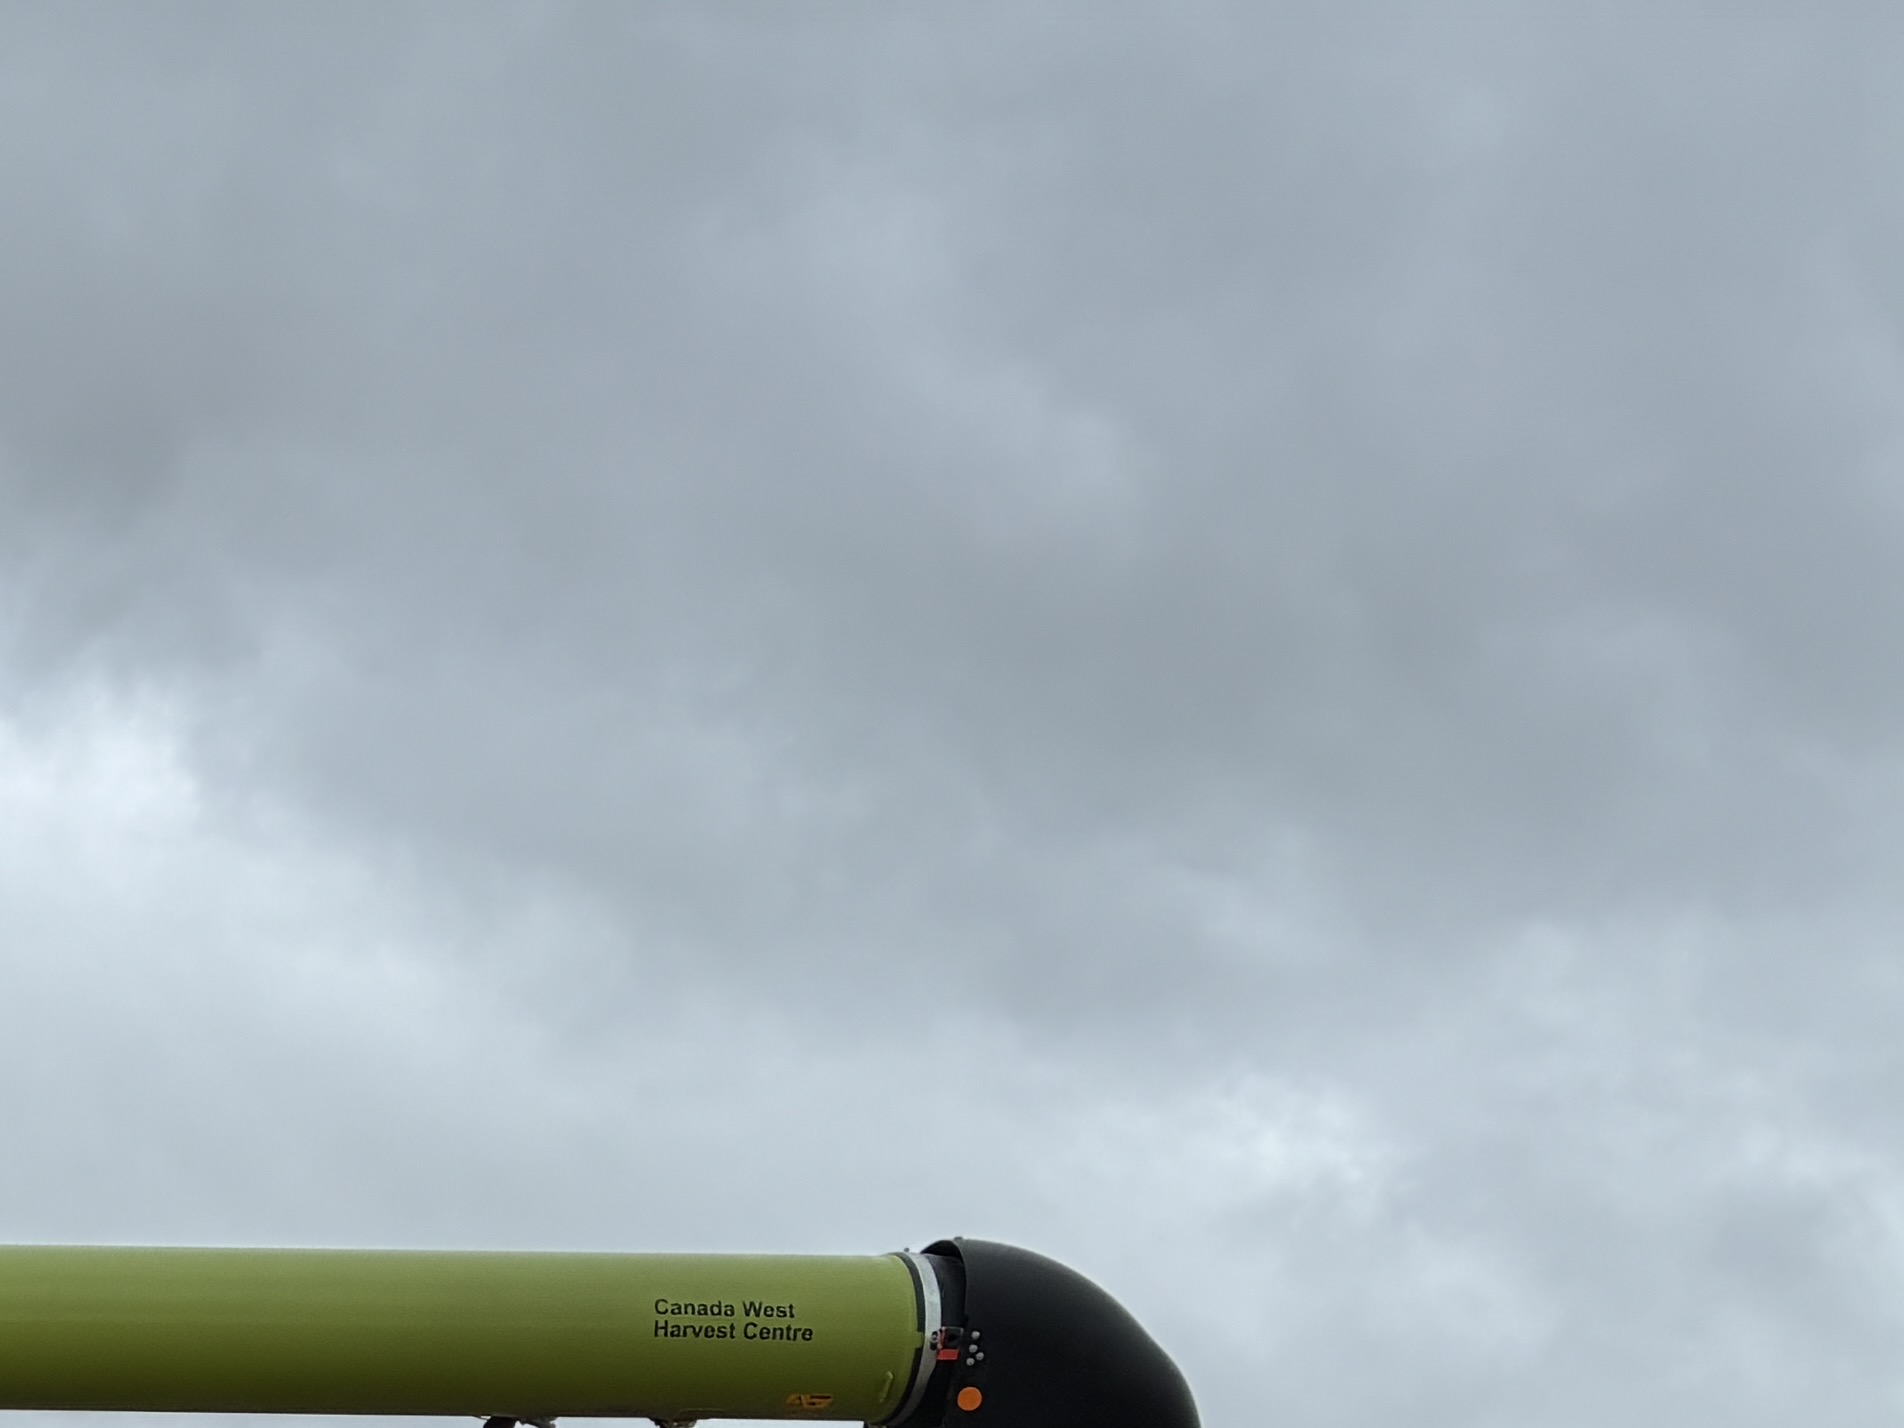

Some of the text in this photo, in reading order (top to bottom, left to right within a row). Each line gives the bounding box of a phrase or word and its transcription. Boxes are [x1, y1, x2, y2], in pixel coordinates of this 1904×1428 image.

[654, 1298, 795, 1318] Canada West
[654, 1320, 813, 1341] Harvest Centre
